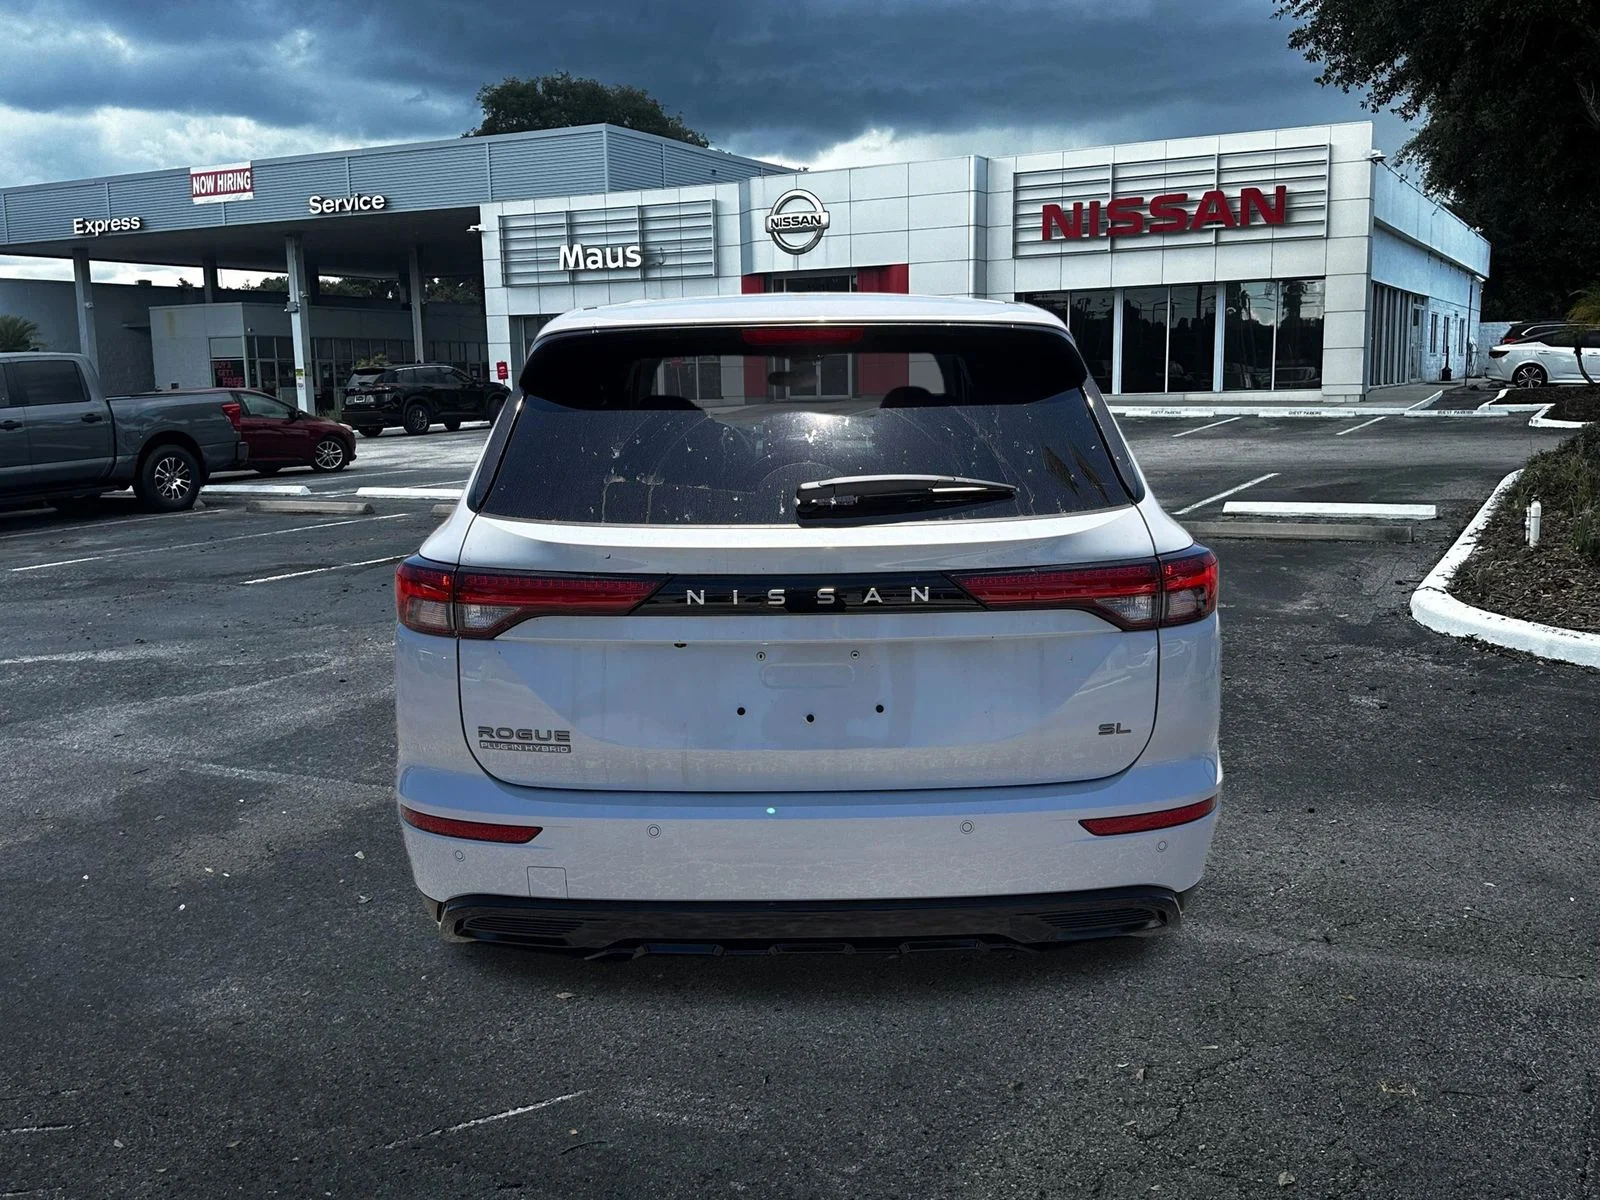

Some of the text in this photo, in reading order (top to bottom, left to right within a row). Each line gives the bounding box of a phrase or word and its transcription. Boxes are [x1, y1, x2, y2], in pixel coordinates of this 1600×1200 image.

[192, 171, 251, 195] NOW HIRING
[308, 192, 385, 214] Service
[1042, 185, 1287, 241] NISSAN
[73, 216, 141, 236] Express
[770, 215, 822, 227] NISSAN
[559, 243, 642, 271] Maus
[222, 376, 244, 386] FREE
[686, 586, 930, 606] NISSAN
[478, 726, 570, 742] ROGUE
[1098, 722, 1132, 735] SL
[480, 742, 569, 753] PLUG-IN HYBRID
